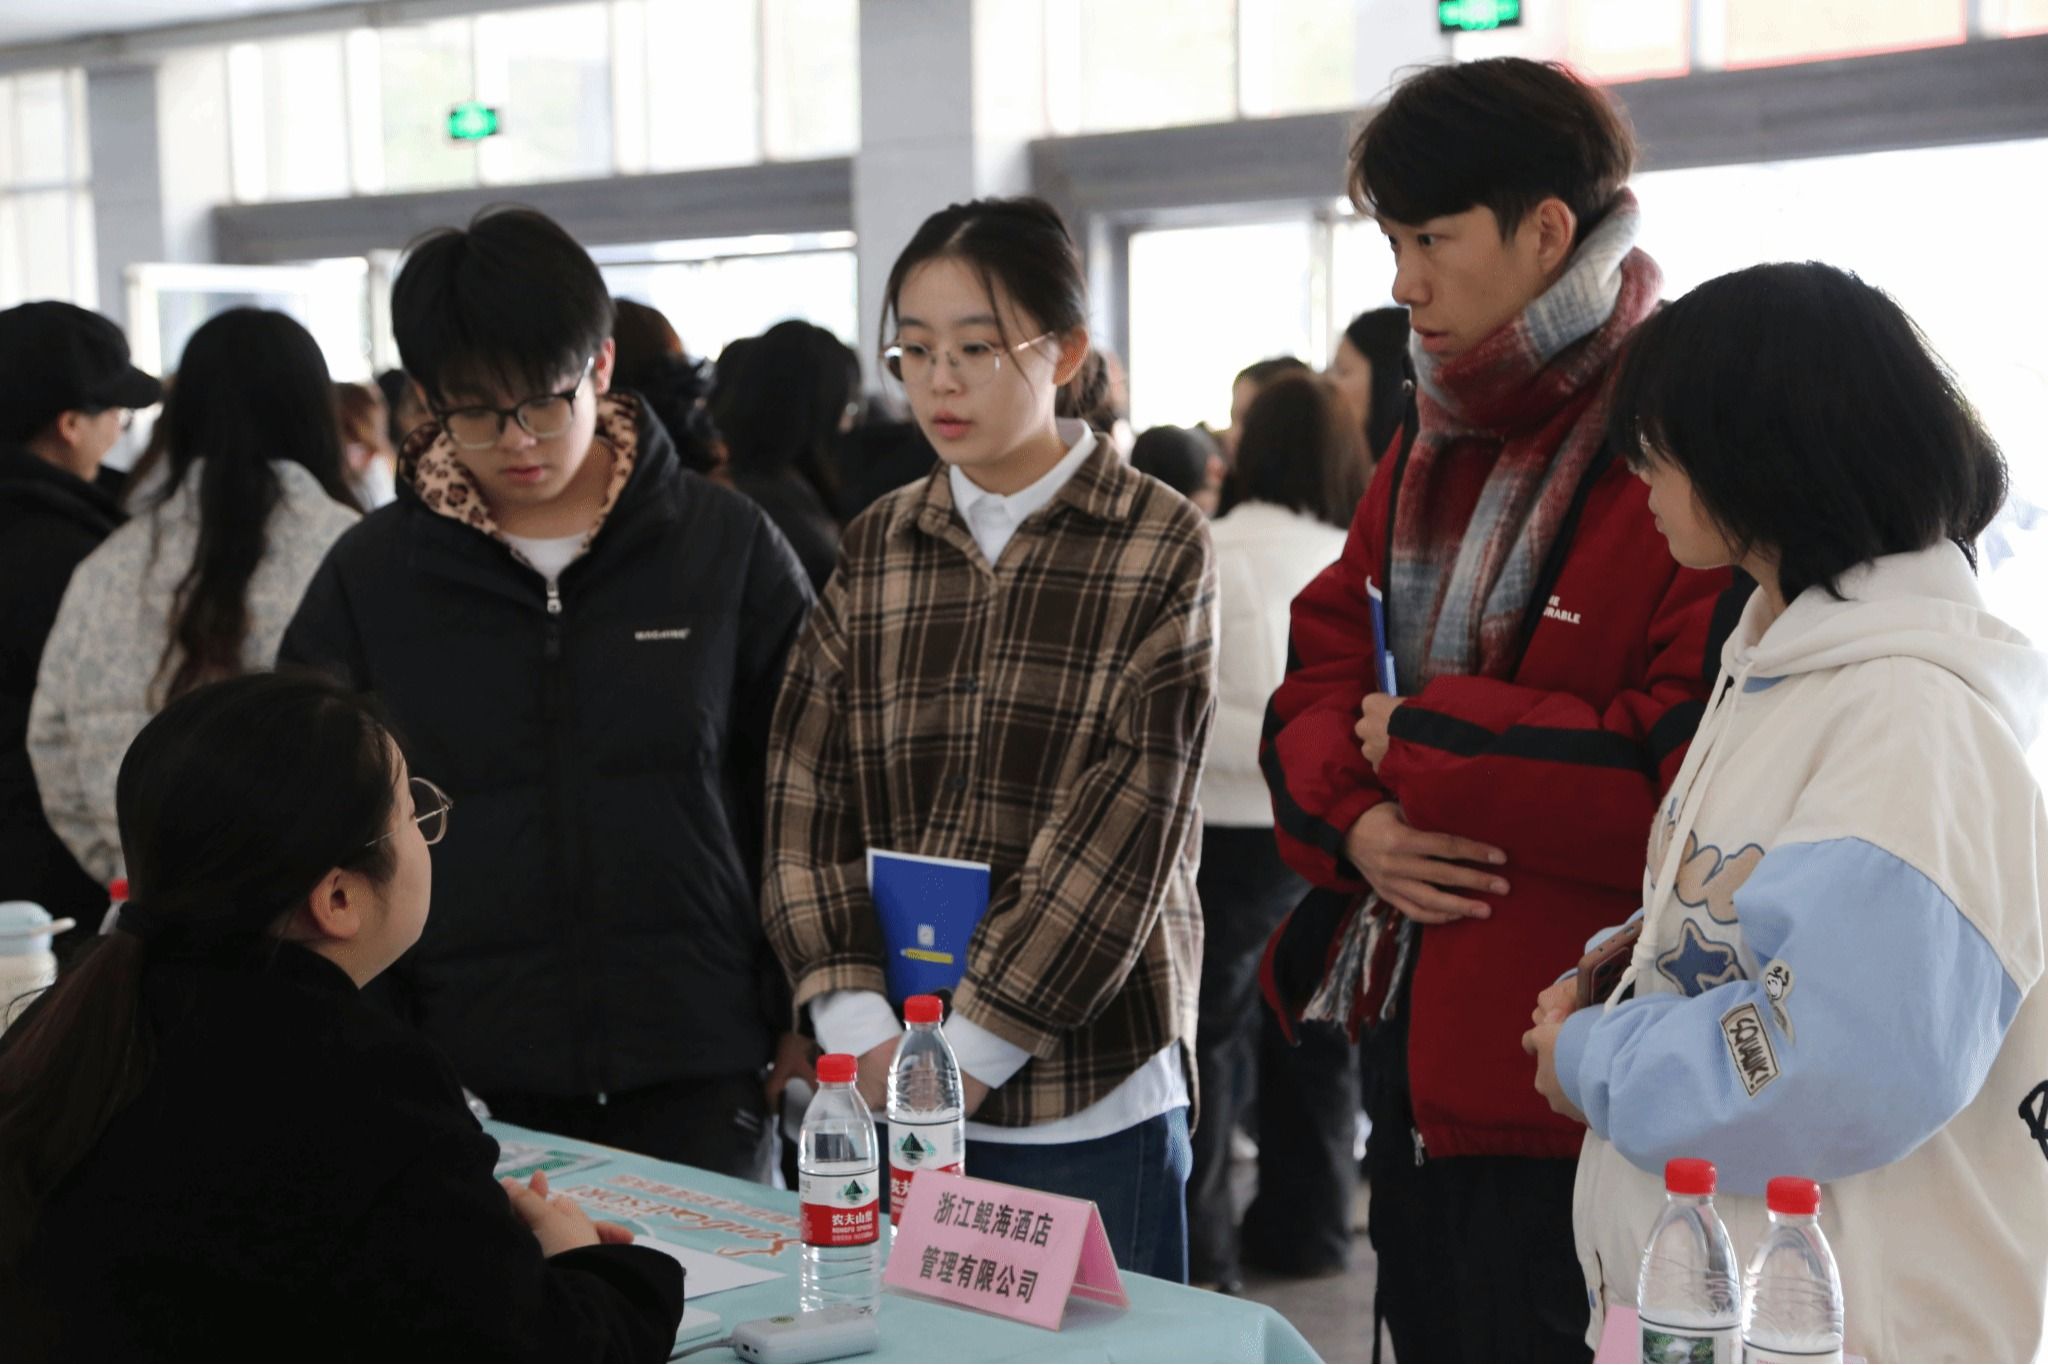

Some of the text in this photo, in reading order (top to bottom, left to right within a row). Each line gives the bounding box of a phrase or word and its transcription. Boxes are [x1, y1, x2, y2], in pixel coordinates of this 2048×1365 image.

[934, 1191, 1054, 1247] 浙江鲲海酒店
[920, 1245, 1039, 1304] 管理有限公司
